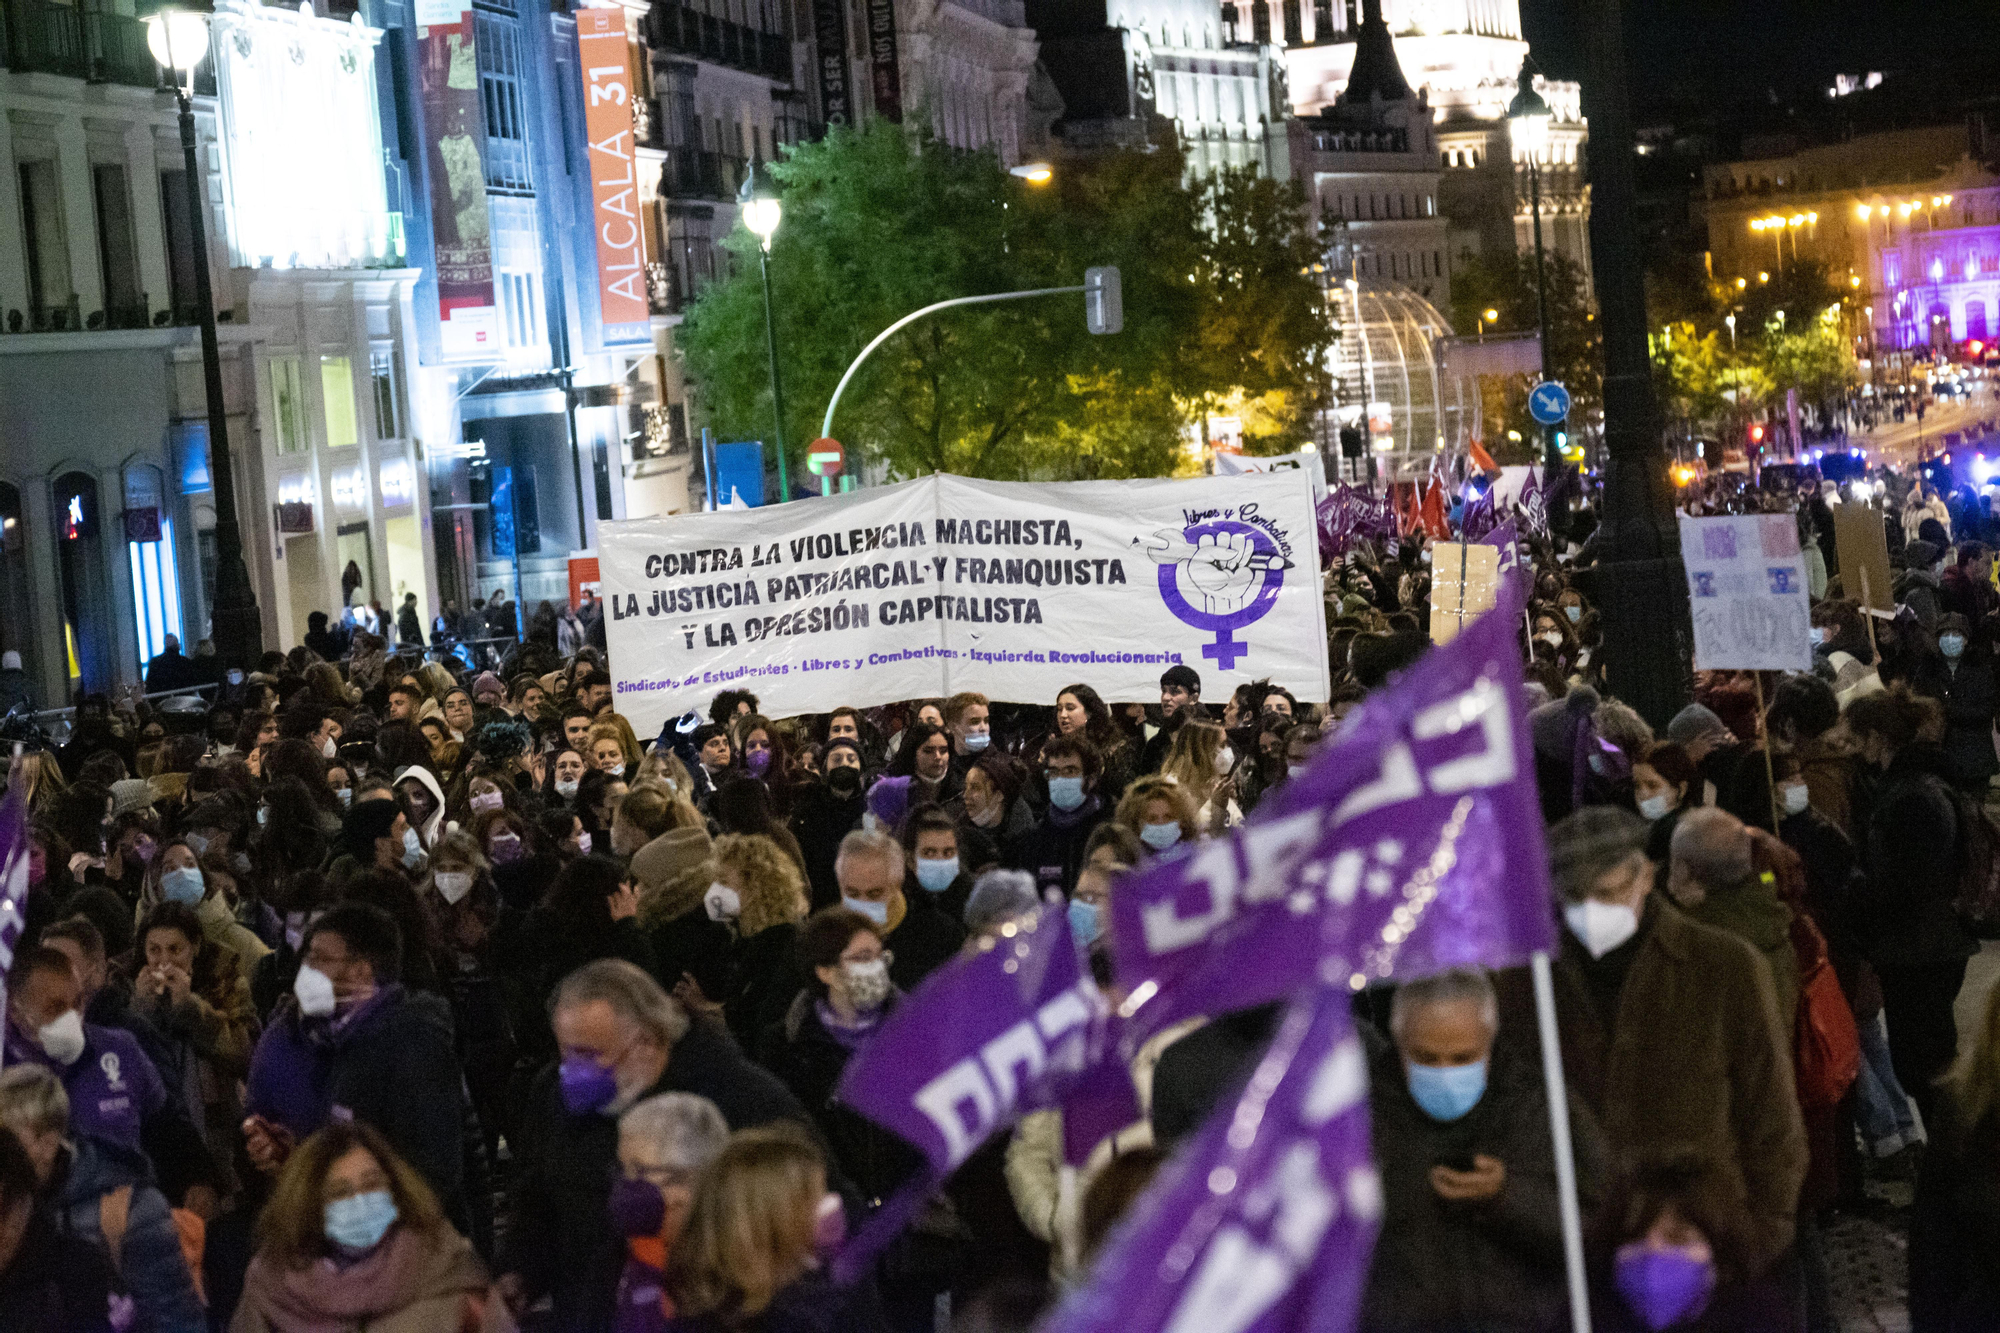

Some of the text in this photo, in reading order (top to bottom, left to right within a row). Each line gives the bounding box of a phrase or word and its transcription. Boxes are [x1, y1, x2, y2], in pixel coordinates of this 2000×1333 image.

[588, 65, 627, 106] 31
[824, 55, 843, 91] SER
[828, 97, 845, 127] OR
[588, 129, 642, 301] ALCALÁ
[609, 326, 646, 340] SALA
[645, 518, 1083, 579] CONTRA LA VIOLENCIA MACHISTA,
[612, 593, 640, 621] LA
[767, 560, 925, 603] PATRIARCAL
[931, 556, 949, 582] Y
[955, 557, 1127, 587] FRANQUISTA
[681, 595, 1043, 650] Y LA OPRESIÓN CAPITALISTA
[616, 678, 681, 694] Sindicato
[683, 674, 700, 686] de
[802, 658, 851, 672] Libres
[854, 657, 864, 670] y
[868, 645, 958, 666] Combativas
[970, 649, 1046, 665] Izquierda
[1048, 649, 1184, 666] Revolucionaria
